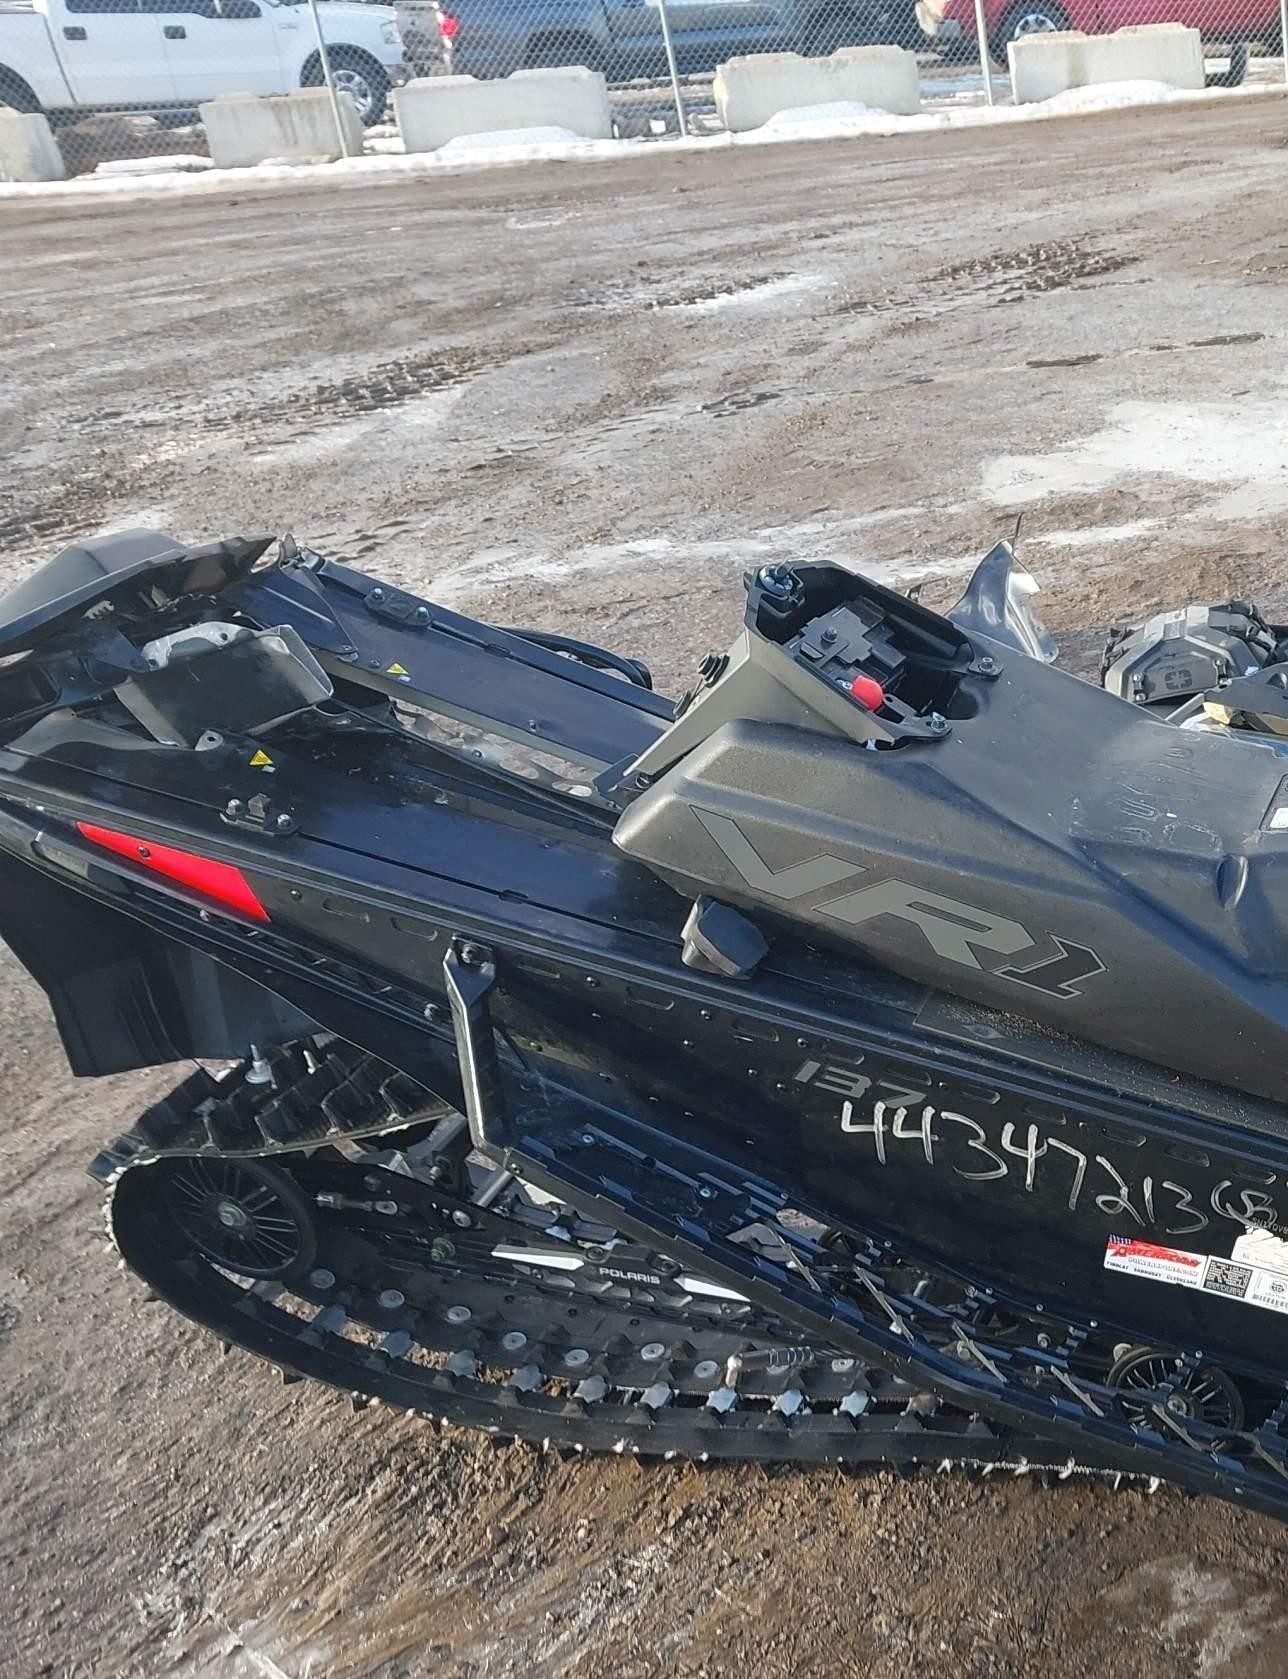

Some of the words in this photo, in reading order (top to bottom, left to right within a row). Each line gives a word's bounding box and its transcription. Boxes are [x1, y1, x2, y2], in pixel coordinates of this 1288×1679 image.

[689, 804, 1108, 998] VR1
[795, 1061, 926, 1108] 137
[599, 1267, 660, 1284] POLARIS
